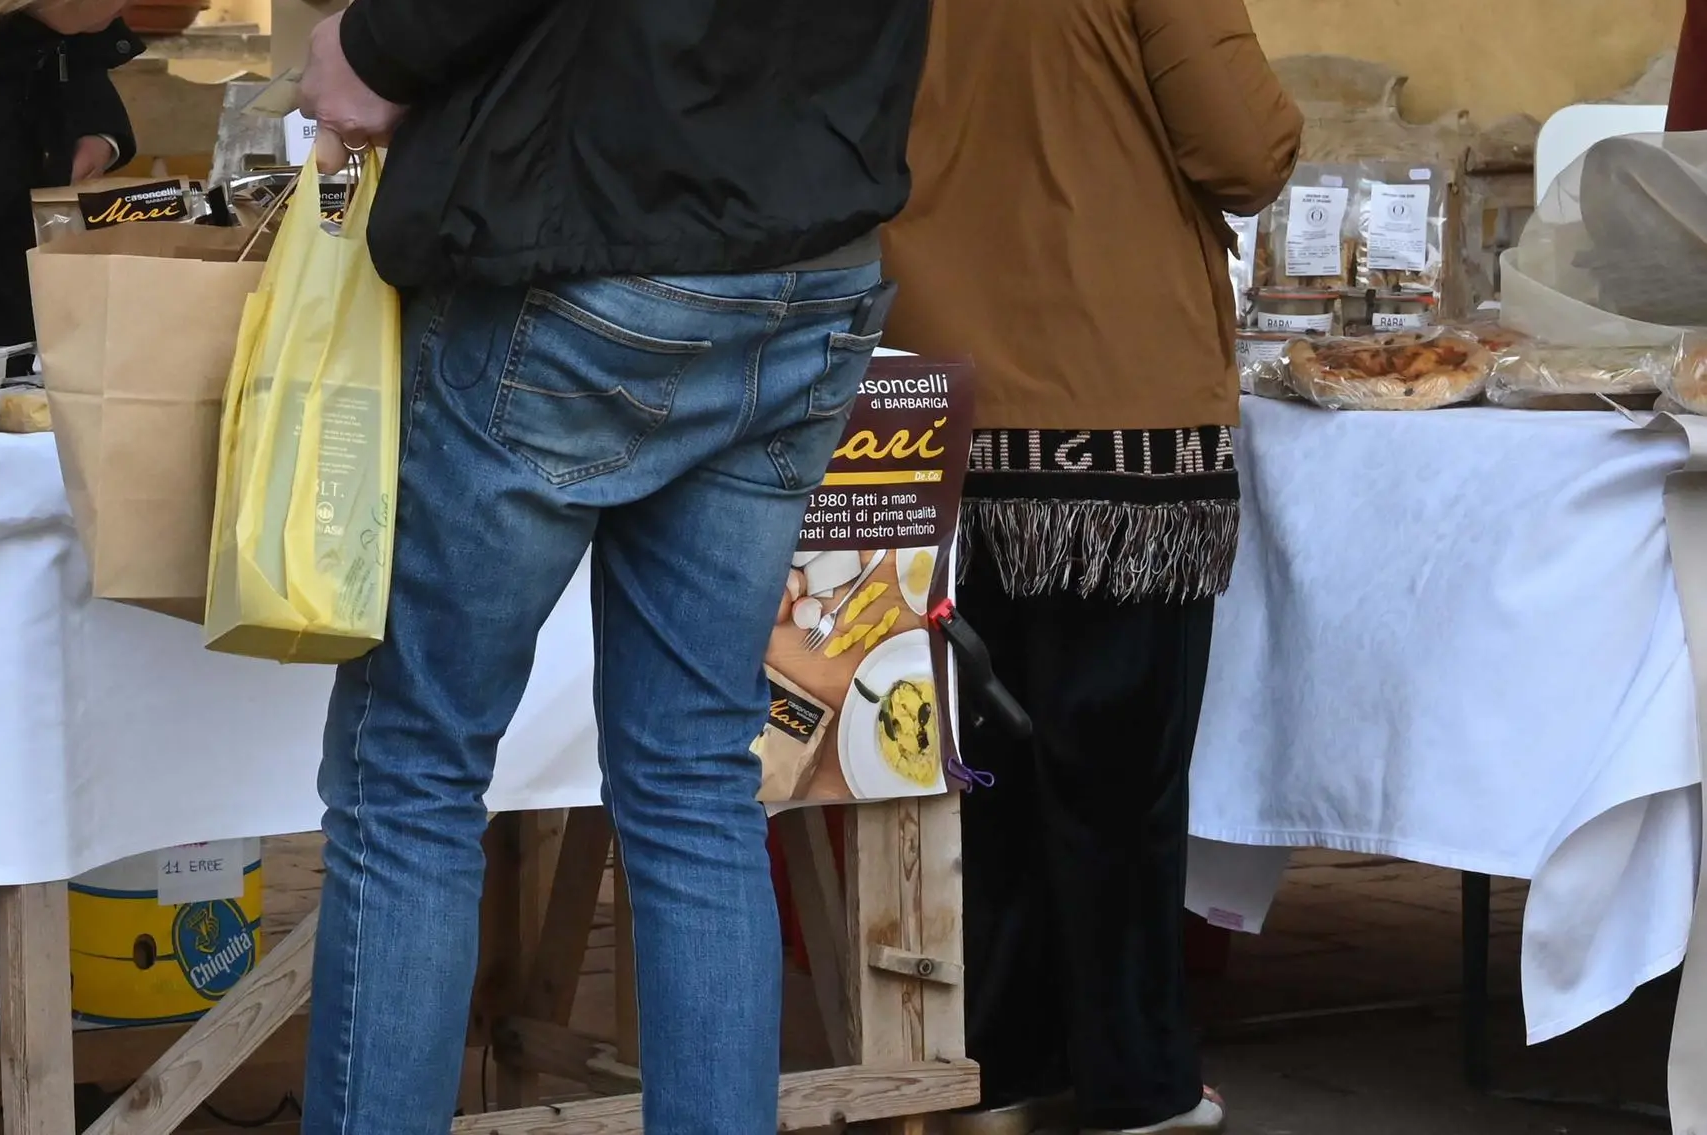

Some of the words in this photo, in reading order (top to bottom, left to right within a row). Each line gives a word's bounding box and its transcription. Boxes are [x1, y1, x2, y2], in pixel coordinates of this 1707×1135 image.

[125, 187, 177, 202] casoncelli
[871, 398, 881, 409] di
[885, 398, 948, 409] BARBARIGA
[809, 494, 847, 507] 1980
[851, 493, 878, 506] fatti
[881, 495, 888, 506] a
[891, 493, 917, 505] mano
[804, 511, 851, 523] edienti
[855, 510, 868, 523] di
[873, 509, 903, 524] prima
[906, 505, 936, 520] qualità
[830, 525, 851, 539] dal
[856, 525, 894, 538] nostro
[896, 522, 935, 537] territorio
[190, 931, 252, 990] Chiquita
